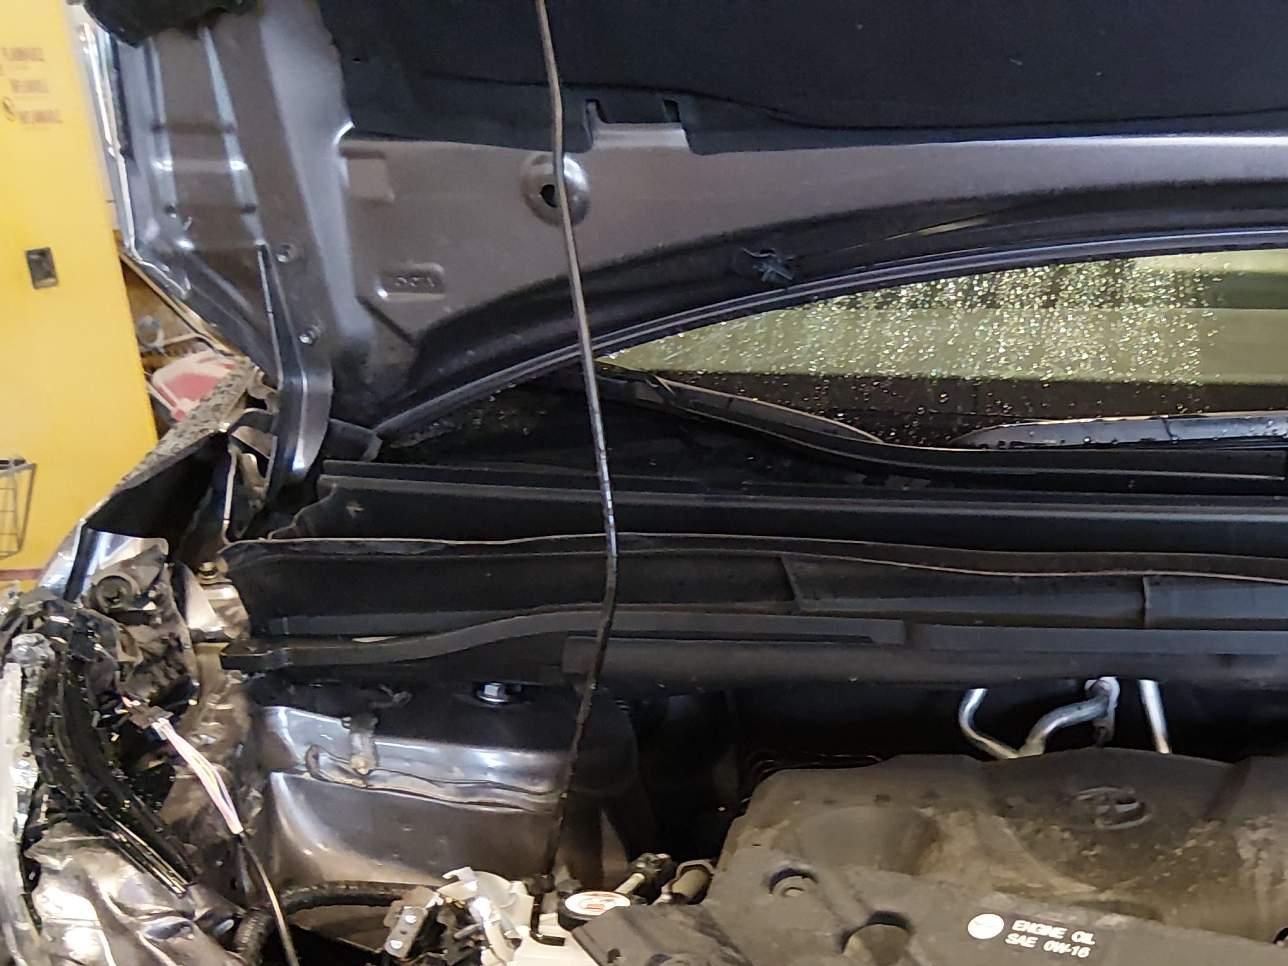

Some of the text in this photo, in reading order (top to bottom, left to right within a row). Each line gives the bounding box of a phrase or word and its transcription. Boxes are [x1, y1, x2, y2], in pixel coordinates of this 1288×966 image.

[1004, 933, 1039, 948] SAE
[1011, 919, 1096, 946] ENGINE OIL
